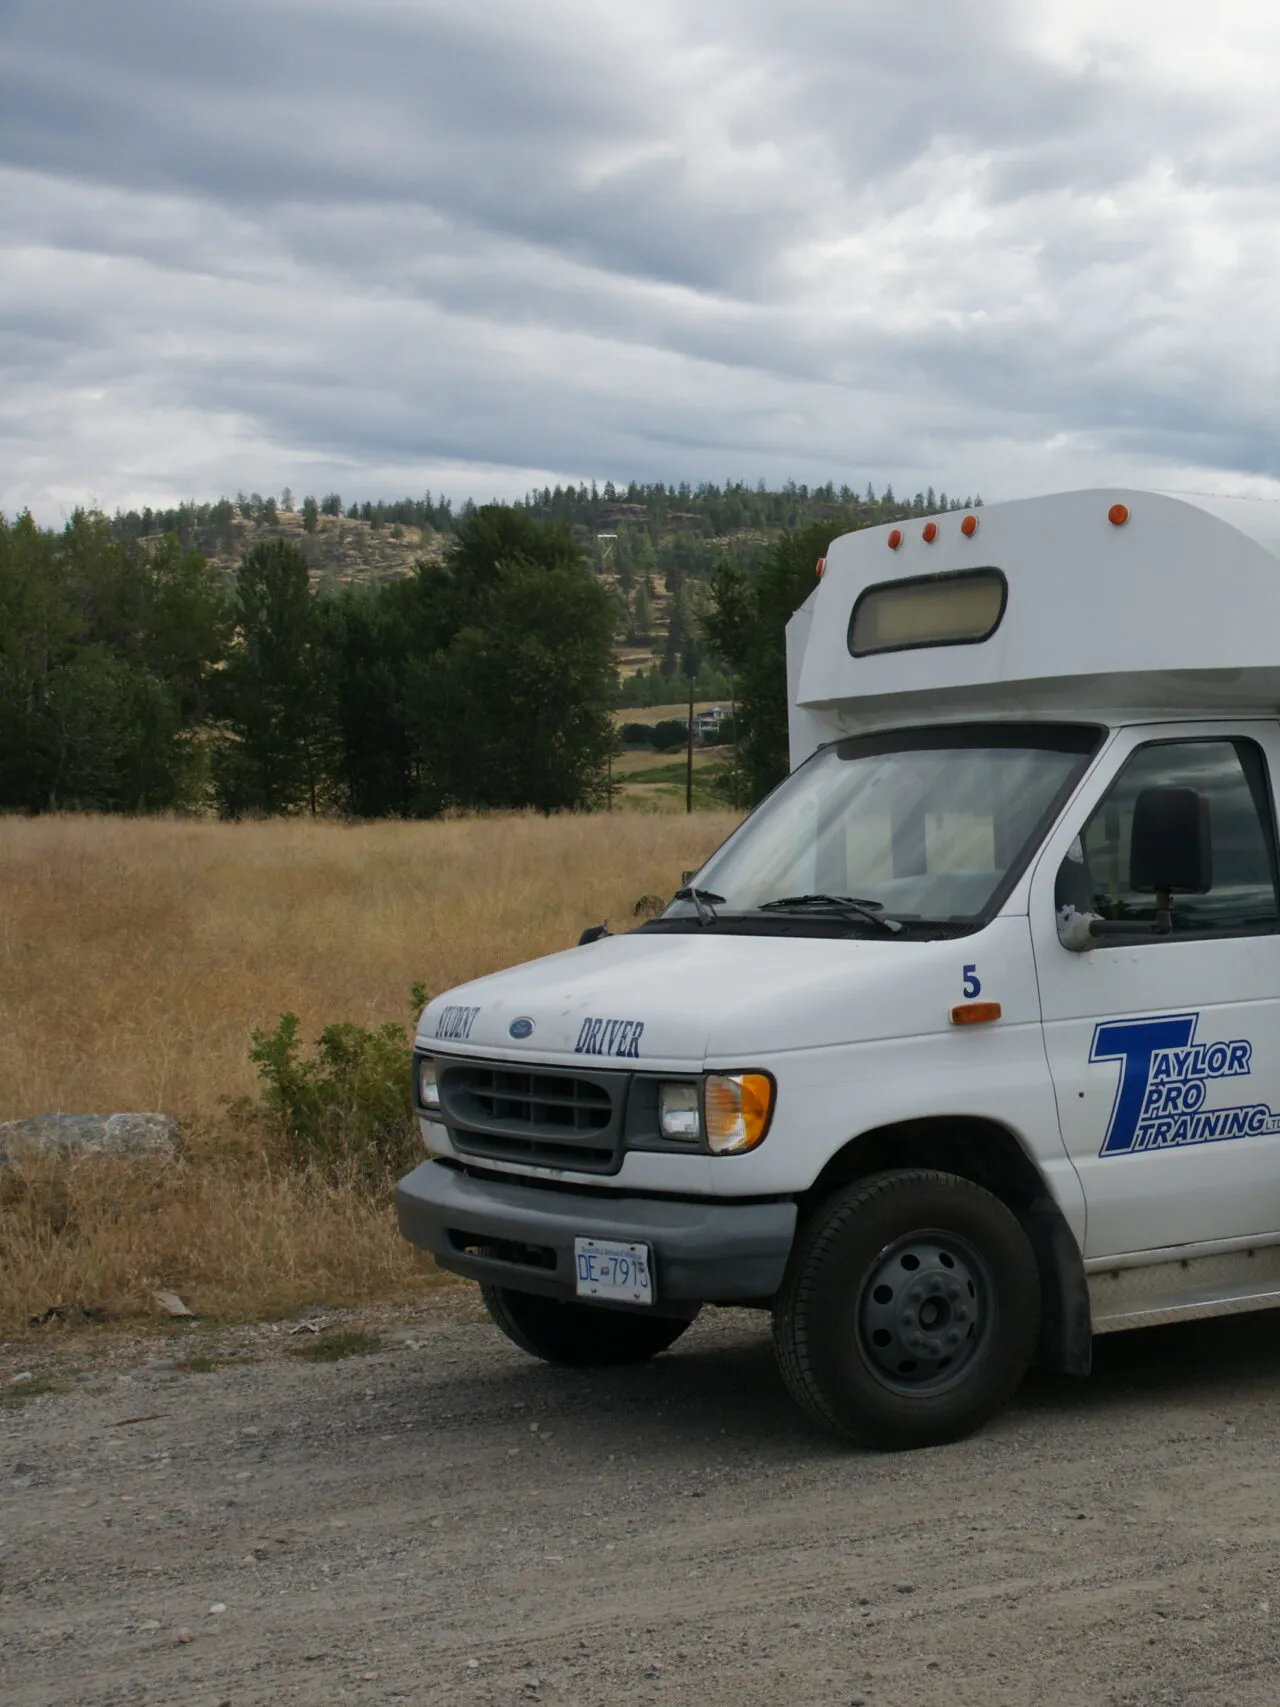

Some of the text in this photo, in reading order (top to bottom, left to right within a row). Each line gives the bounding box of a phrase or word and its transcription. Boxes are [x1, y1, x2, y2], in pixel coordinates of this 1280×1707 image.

[963, 964, 981, 999] 5
[435, 1006, 481, 1039] STUDENT
[574, 1017, 644, 1058] DRIVER
[1089, 1012, 1252, 1158] TAYLOR
[1143, 1079, 1206, 1116] PRO
[1135, 1108, 1267, 1149] TRAINING
[577, 1254, 599, 1282] DE
